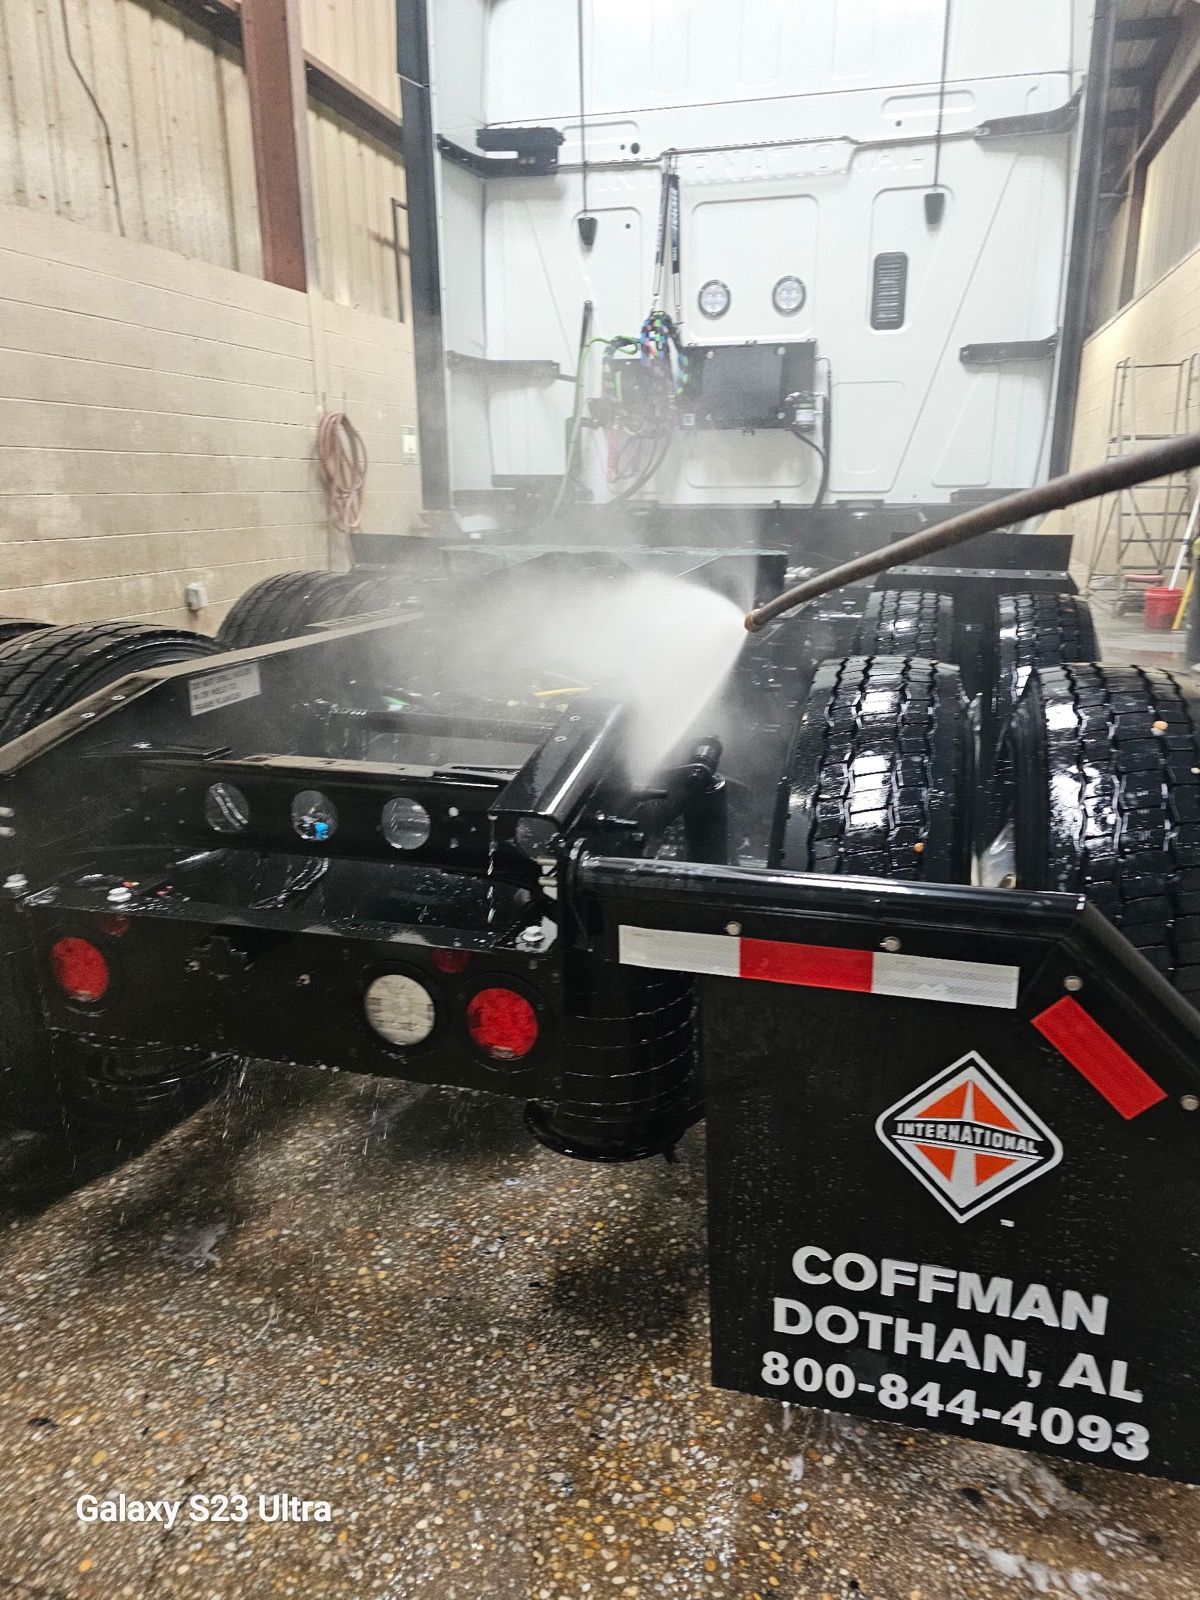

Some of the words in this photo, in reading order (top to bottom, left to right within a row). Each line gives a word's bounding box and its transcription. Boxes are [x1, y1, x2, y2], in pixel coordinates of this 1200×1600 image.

[896, 1122, 1039, 1154] INTERNATIONAL
[791, 1245, 1108, 1335] COFFMAN
[773, 1297, 1043, 1388] DOTHAN,
[1059, 1352, 1143, 1404] AL
[760, 1350, 1150, 1462] 800-844-4093
